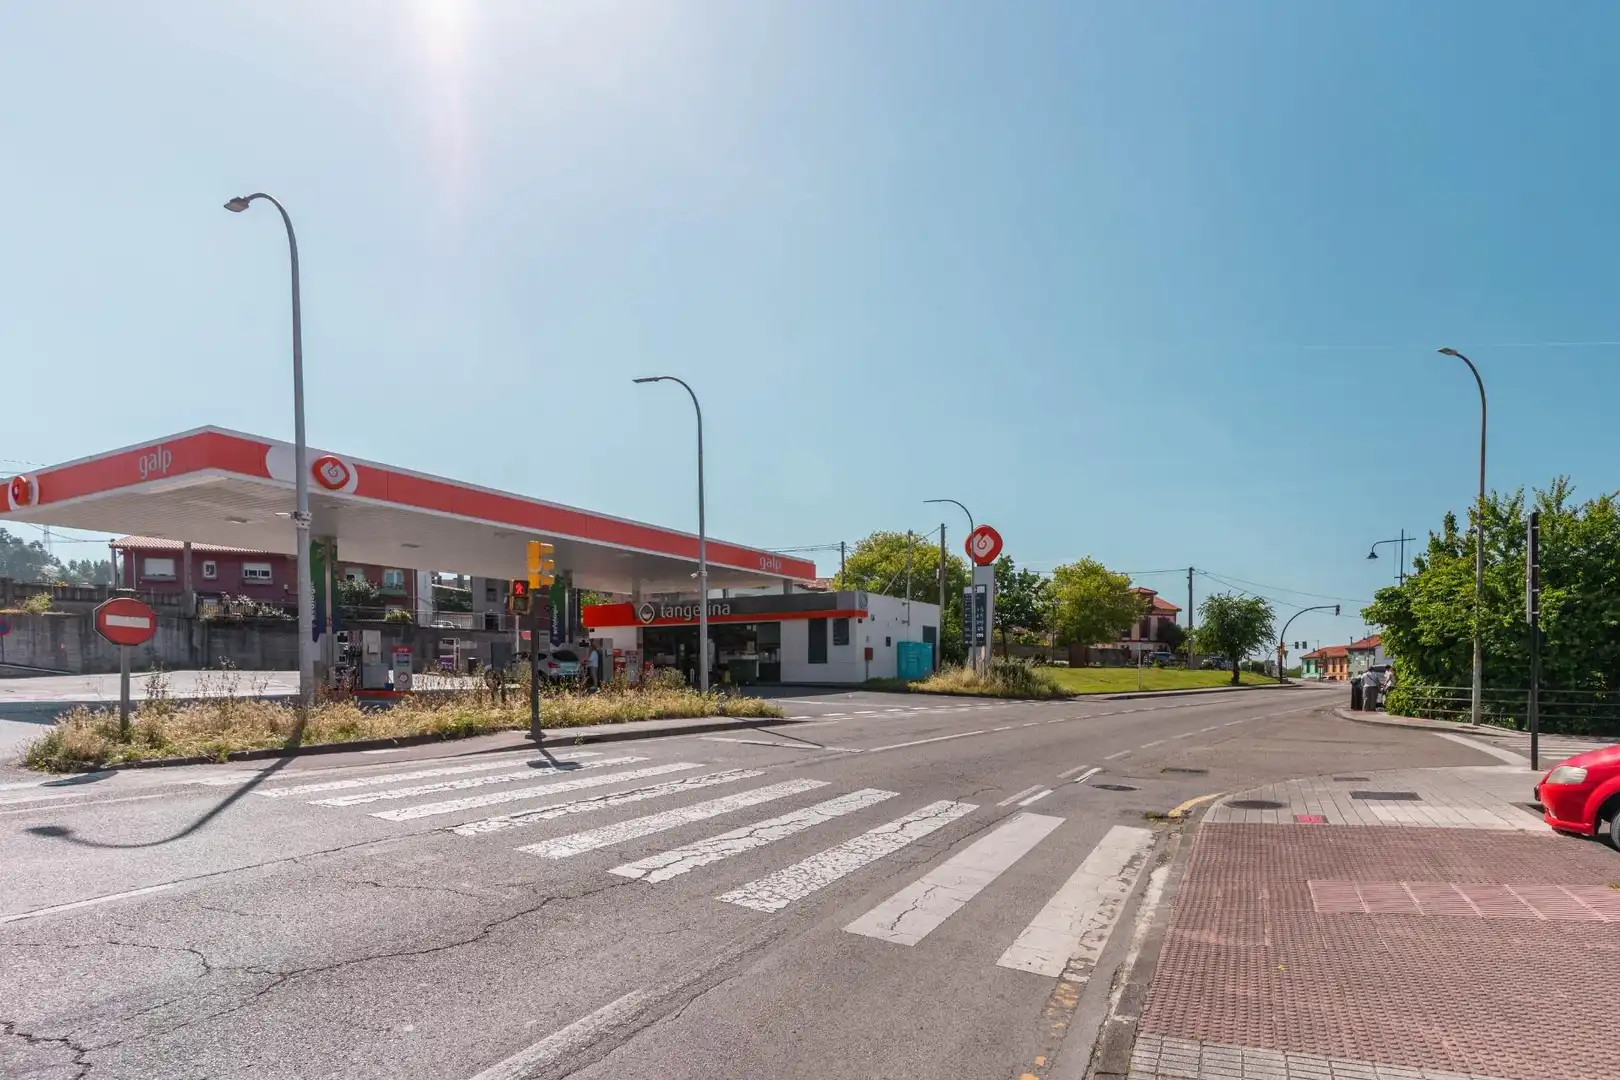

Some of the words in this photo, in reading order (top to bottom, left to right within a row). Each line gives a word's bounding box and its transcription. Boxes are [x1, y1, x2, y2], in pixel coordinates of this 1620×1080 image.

[139, 445, 172, 480] galp
[760, 556, 781, 572] galp
[661, 601, 730, 620] tangeina
